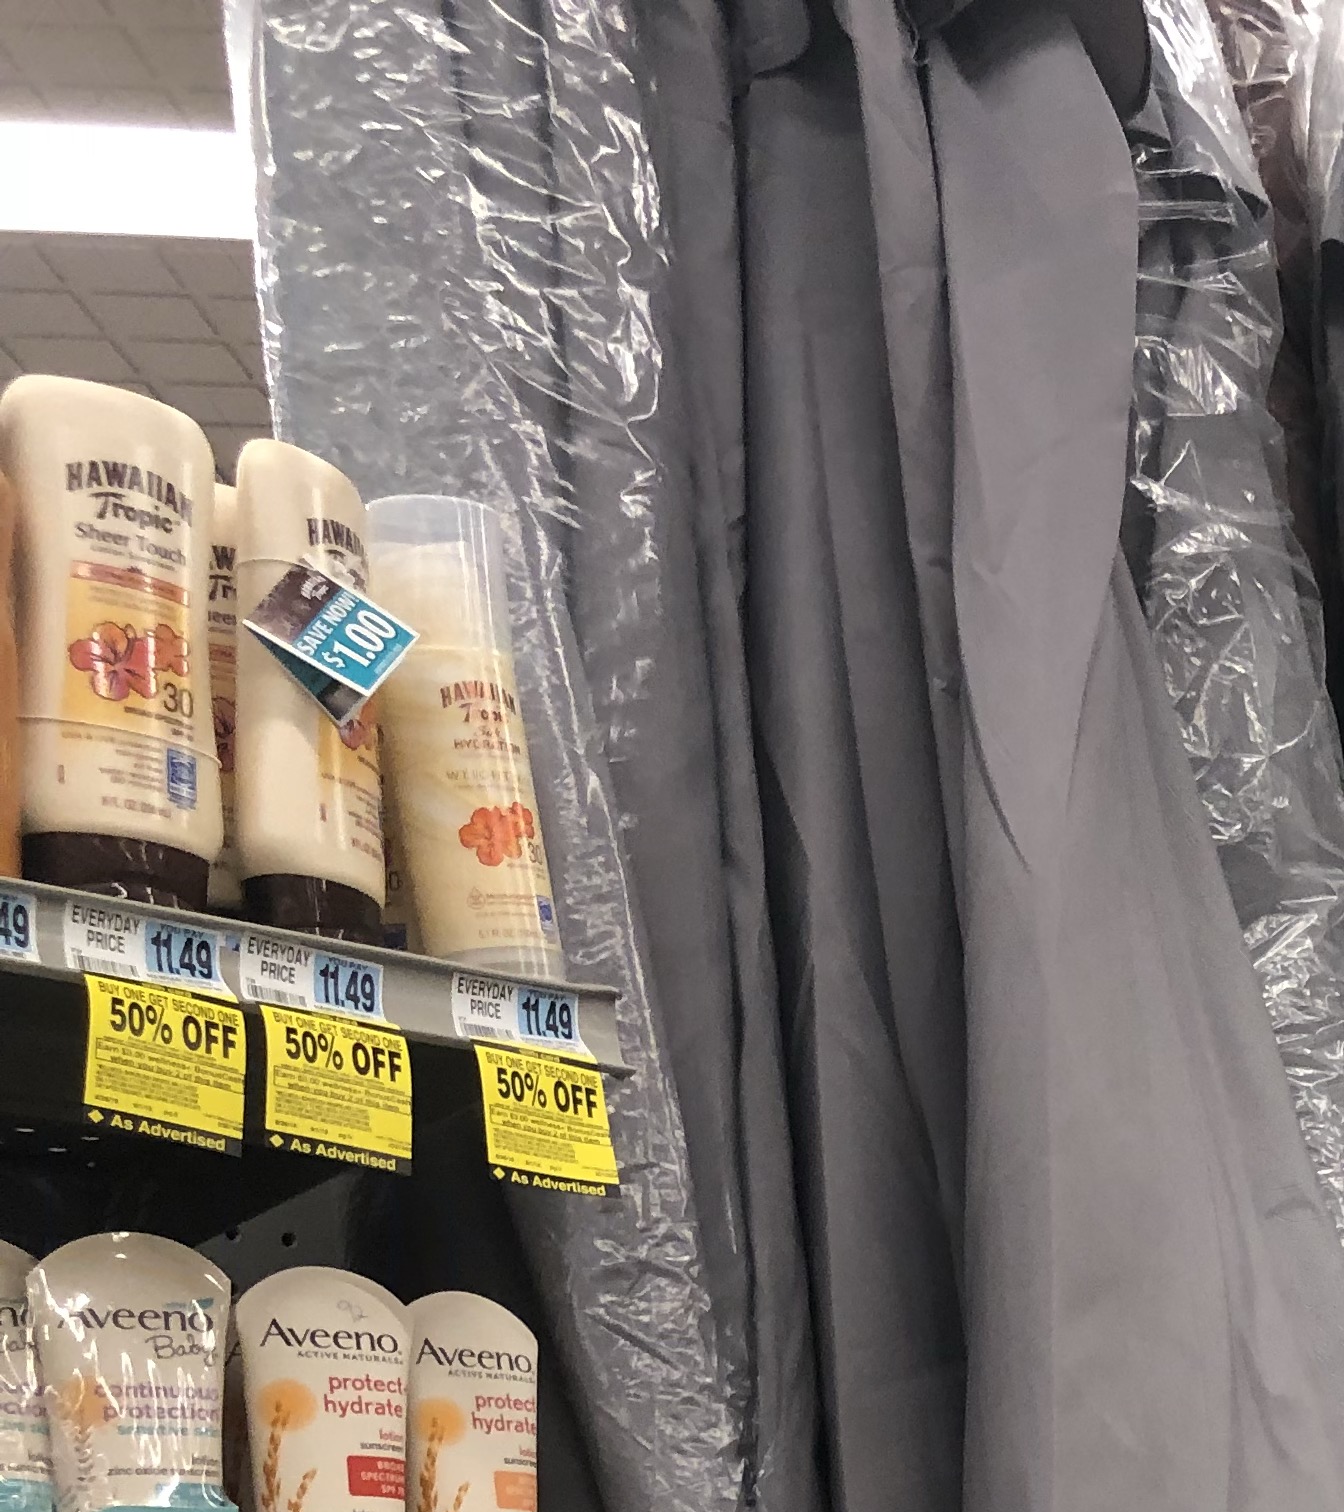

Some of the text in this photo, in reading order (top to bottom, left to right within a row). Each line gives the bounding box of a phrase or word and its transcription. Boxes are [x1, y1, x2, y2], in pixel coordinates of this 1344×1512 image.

[65, 459, 193, 527] HAWAIIAN
[89, 491, 176, 534] Tropic
[74, 521, 131, 547] Sheer
[134, 533, 187, 566] Touch
[296, 619, 334, 657] SAVE
[324, 590, 360, 629] NOW!
[321, 608, 398, 669] $1.00
[163, 681, 195, 719] 30
[71, 903, 141, 936] EVERYDAY
[86, 929, 213, 980] PRICE 11.49
[247, 936, 311, 968] EVERYDAY
[98, 980, 240, 1028] BUY ONE GET SECOND ONE
[260, 959, 376, 1014] PRICE 11.49
[457, 975, 514, 1003] EVERYDAY
[109, 996, 238, 1059] 50% OFF
[272, 1010, 404, 1053] BUY ONE GET SECOND ONE
[469, 995, 574, 1041] PRICE 11.49
[285, 1025, 402, 1084] 50% OFF
[485, 1051, 599, 1089] BUY ONE GET SECOND ONE
[496, 1066, 599, 1119] 50% OFF
[110, 1113, 227, 1153] As Advertised
[290, 1137, 397, 1173] As Advertised
[511, 1170, 607, 1198] As Advertised
[57, 1306, 215, 1333] Aveeno
[259, 1317, 400, 1356] Aveeno
[415, 1337, 532, 1374] Aveeno
[328, 1373, 403, 1396] protect
[323, 1393, 404, 1419] hydrate
